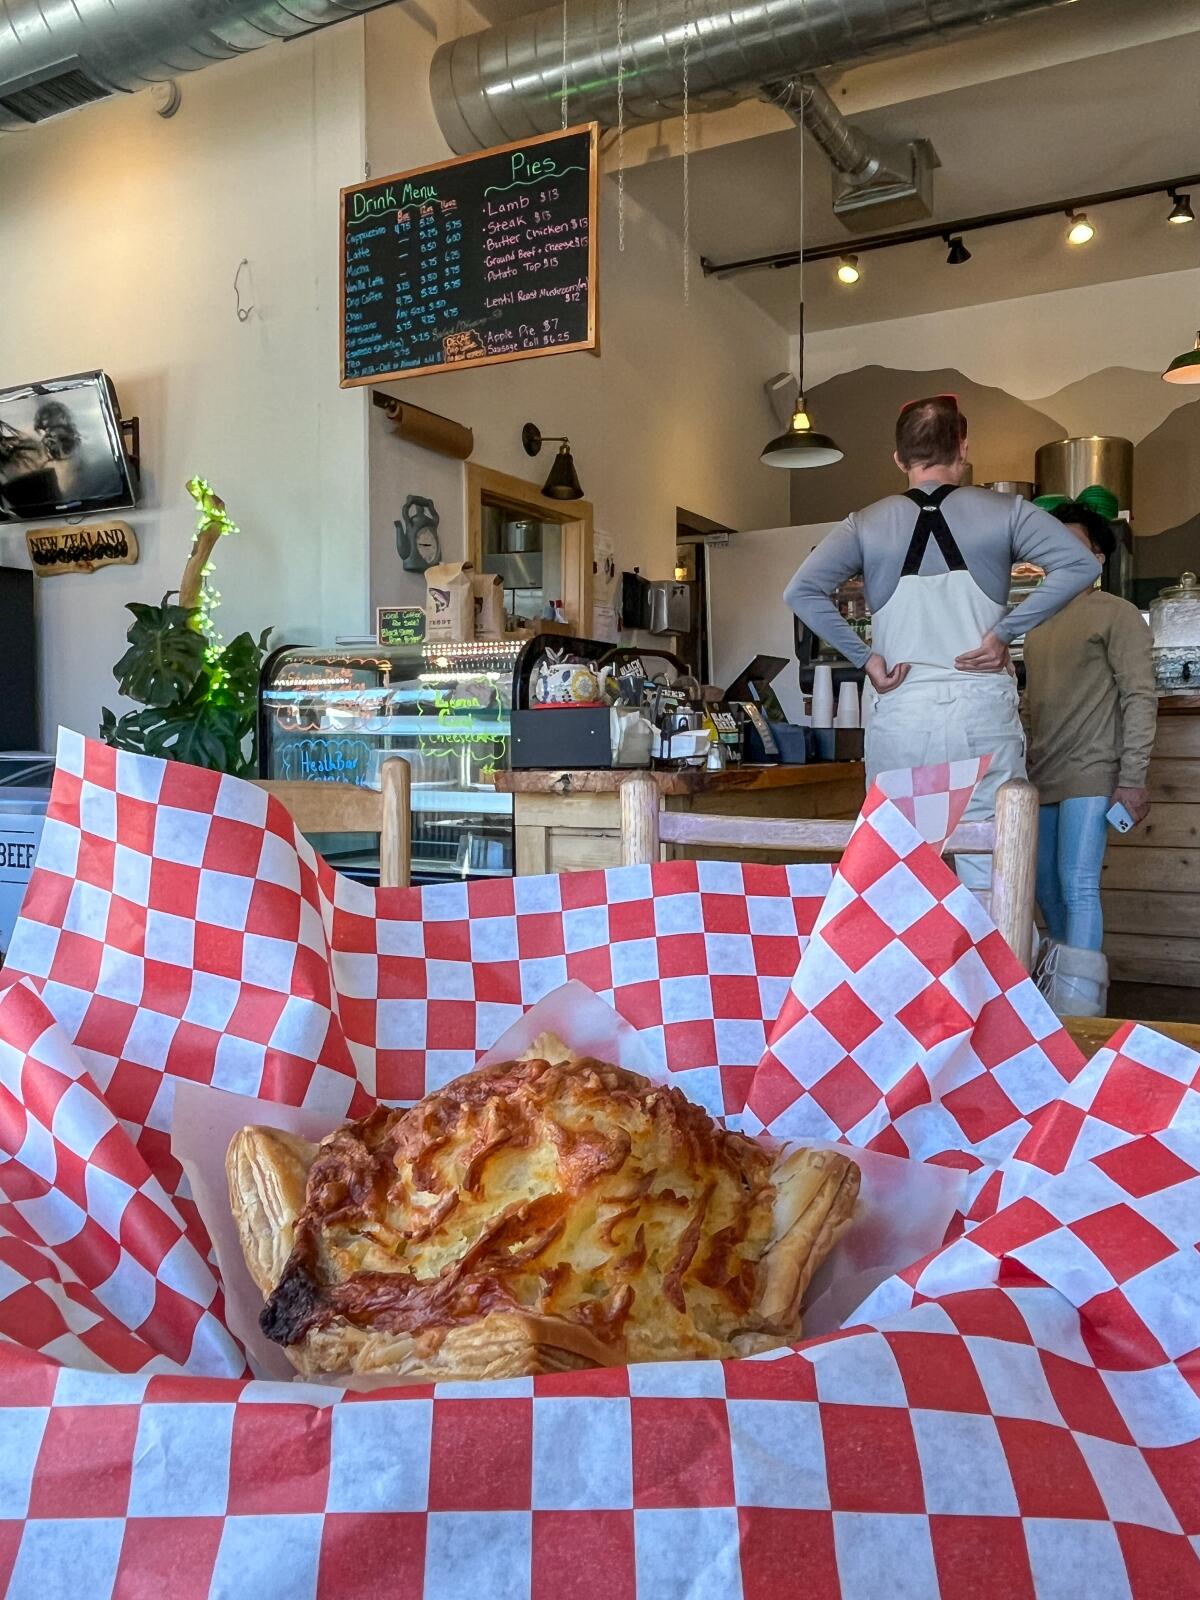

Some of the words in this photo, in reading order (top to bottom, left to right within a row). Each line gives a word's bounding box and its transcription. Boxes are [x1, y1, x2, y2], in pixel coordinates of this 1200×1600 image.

[511, 152, 556, 181] Pies
[354, 187, 397, 217] Drink
[402, 183, 438, 203] Menu
[487, 195, 530, 216] Lamb
[486, 233, 520, 251] Butter
[526, 222, 569, 240] Chicken
[487, 216, 527, 235] Steak
[486, 250, 515, 267] Ground
[518, 246, 536, 259] Beef
[544, 240, 574, 253] Cheese
[487, 266, 518, 282] Potato
[523, 261, 541, 272] Top
[486, 292, 514, 308] Lentil
[565, 292, 580, 303] $12
[487, 331, 513, 343] Apple
[518, 325, 536, 338] Pie
[542, 318, 559, 332] $7
[487, 343, 518, 354] Sausage
[523, 337, 539, 348] Roll
[29, 536, 58, 554] NEW
[62, 529, 126, 549] ZEALAND
[0, 842, 35, 868] BEEF
